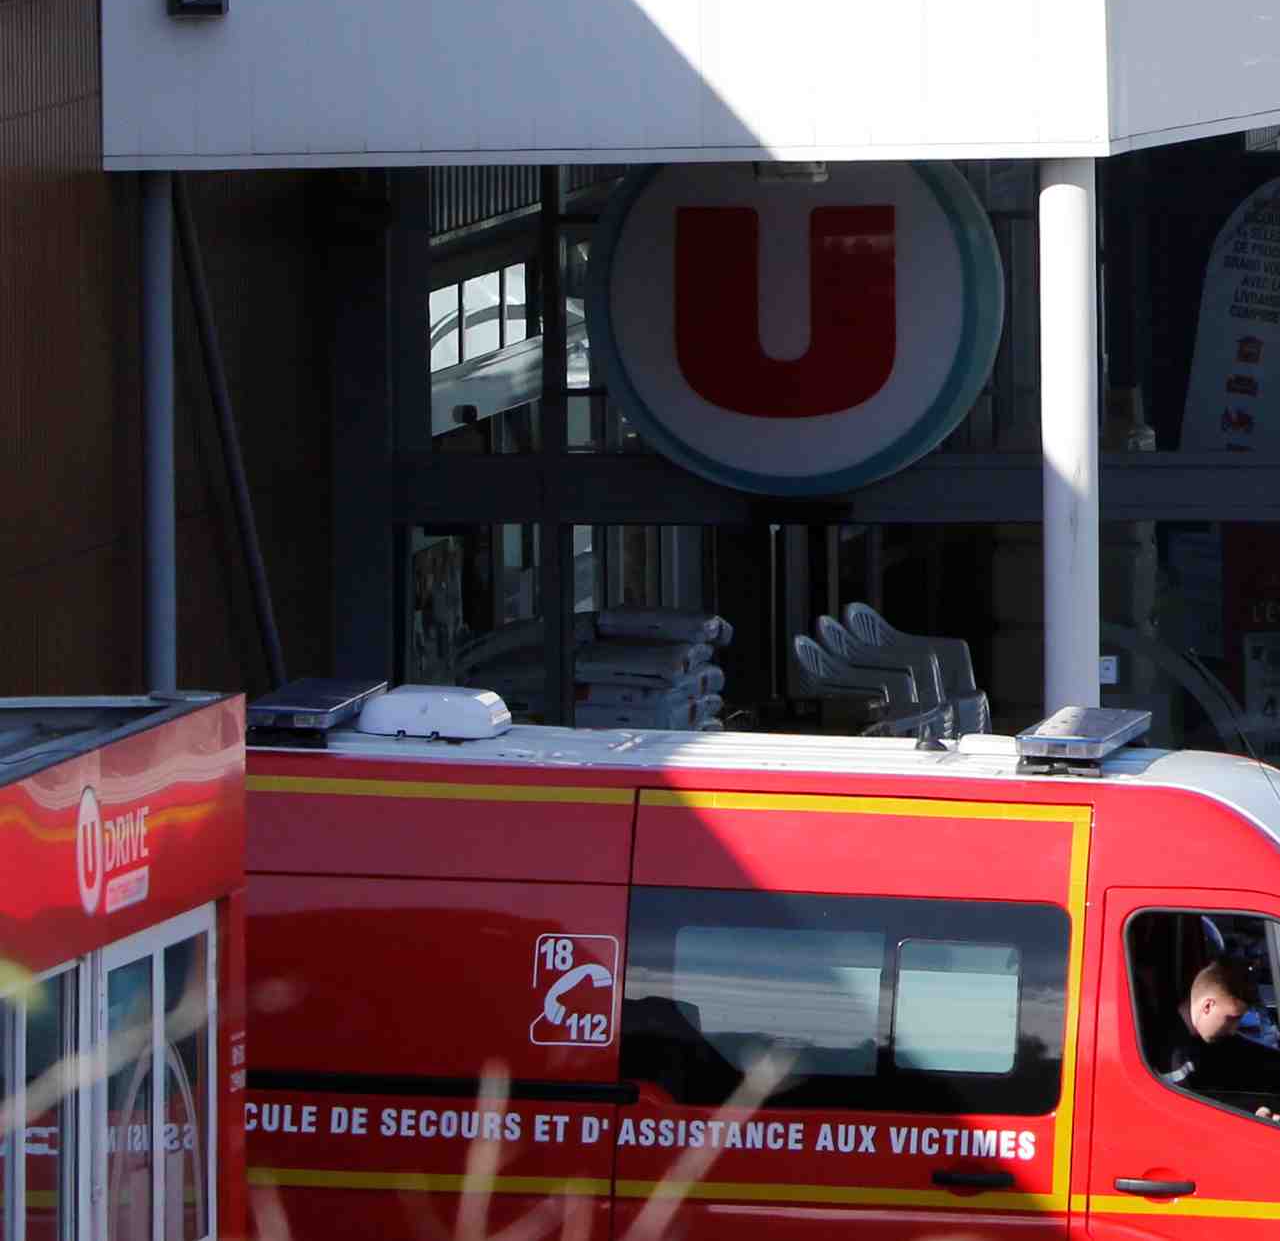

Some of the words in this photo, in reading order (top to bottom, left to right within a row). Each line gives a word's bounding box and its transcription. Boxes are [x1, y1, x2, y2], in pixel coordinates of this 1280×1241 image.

[674, 205, 896, 419] U
[104, 806, 150, 871] DRIVE
[540, 938, 574, 971] 18
[566, 1013, 608, 1041] 112
[330, 1106, 369, 1135] DE
[380, 1109, 522, 1141] SECOURS
[534, 1115, 570, 1143] ET
[581, 1116, 611, 1143] D'
[616, 1118, 805, 1150] ASSISTANCE
[815, 1123, 877, 1154] AUX
[888, 1127, 1037, 1160] VICTIMES
